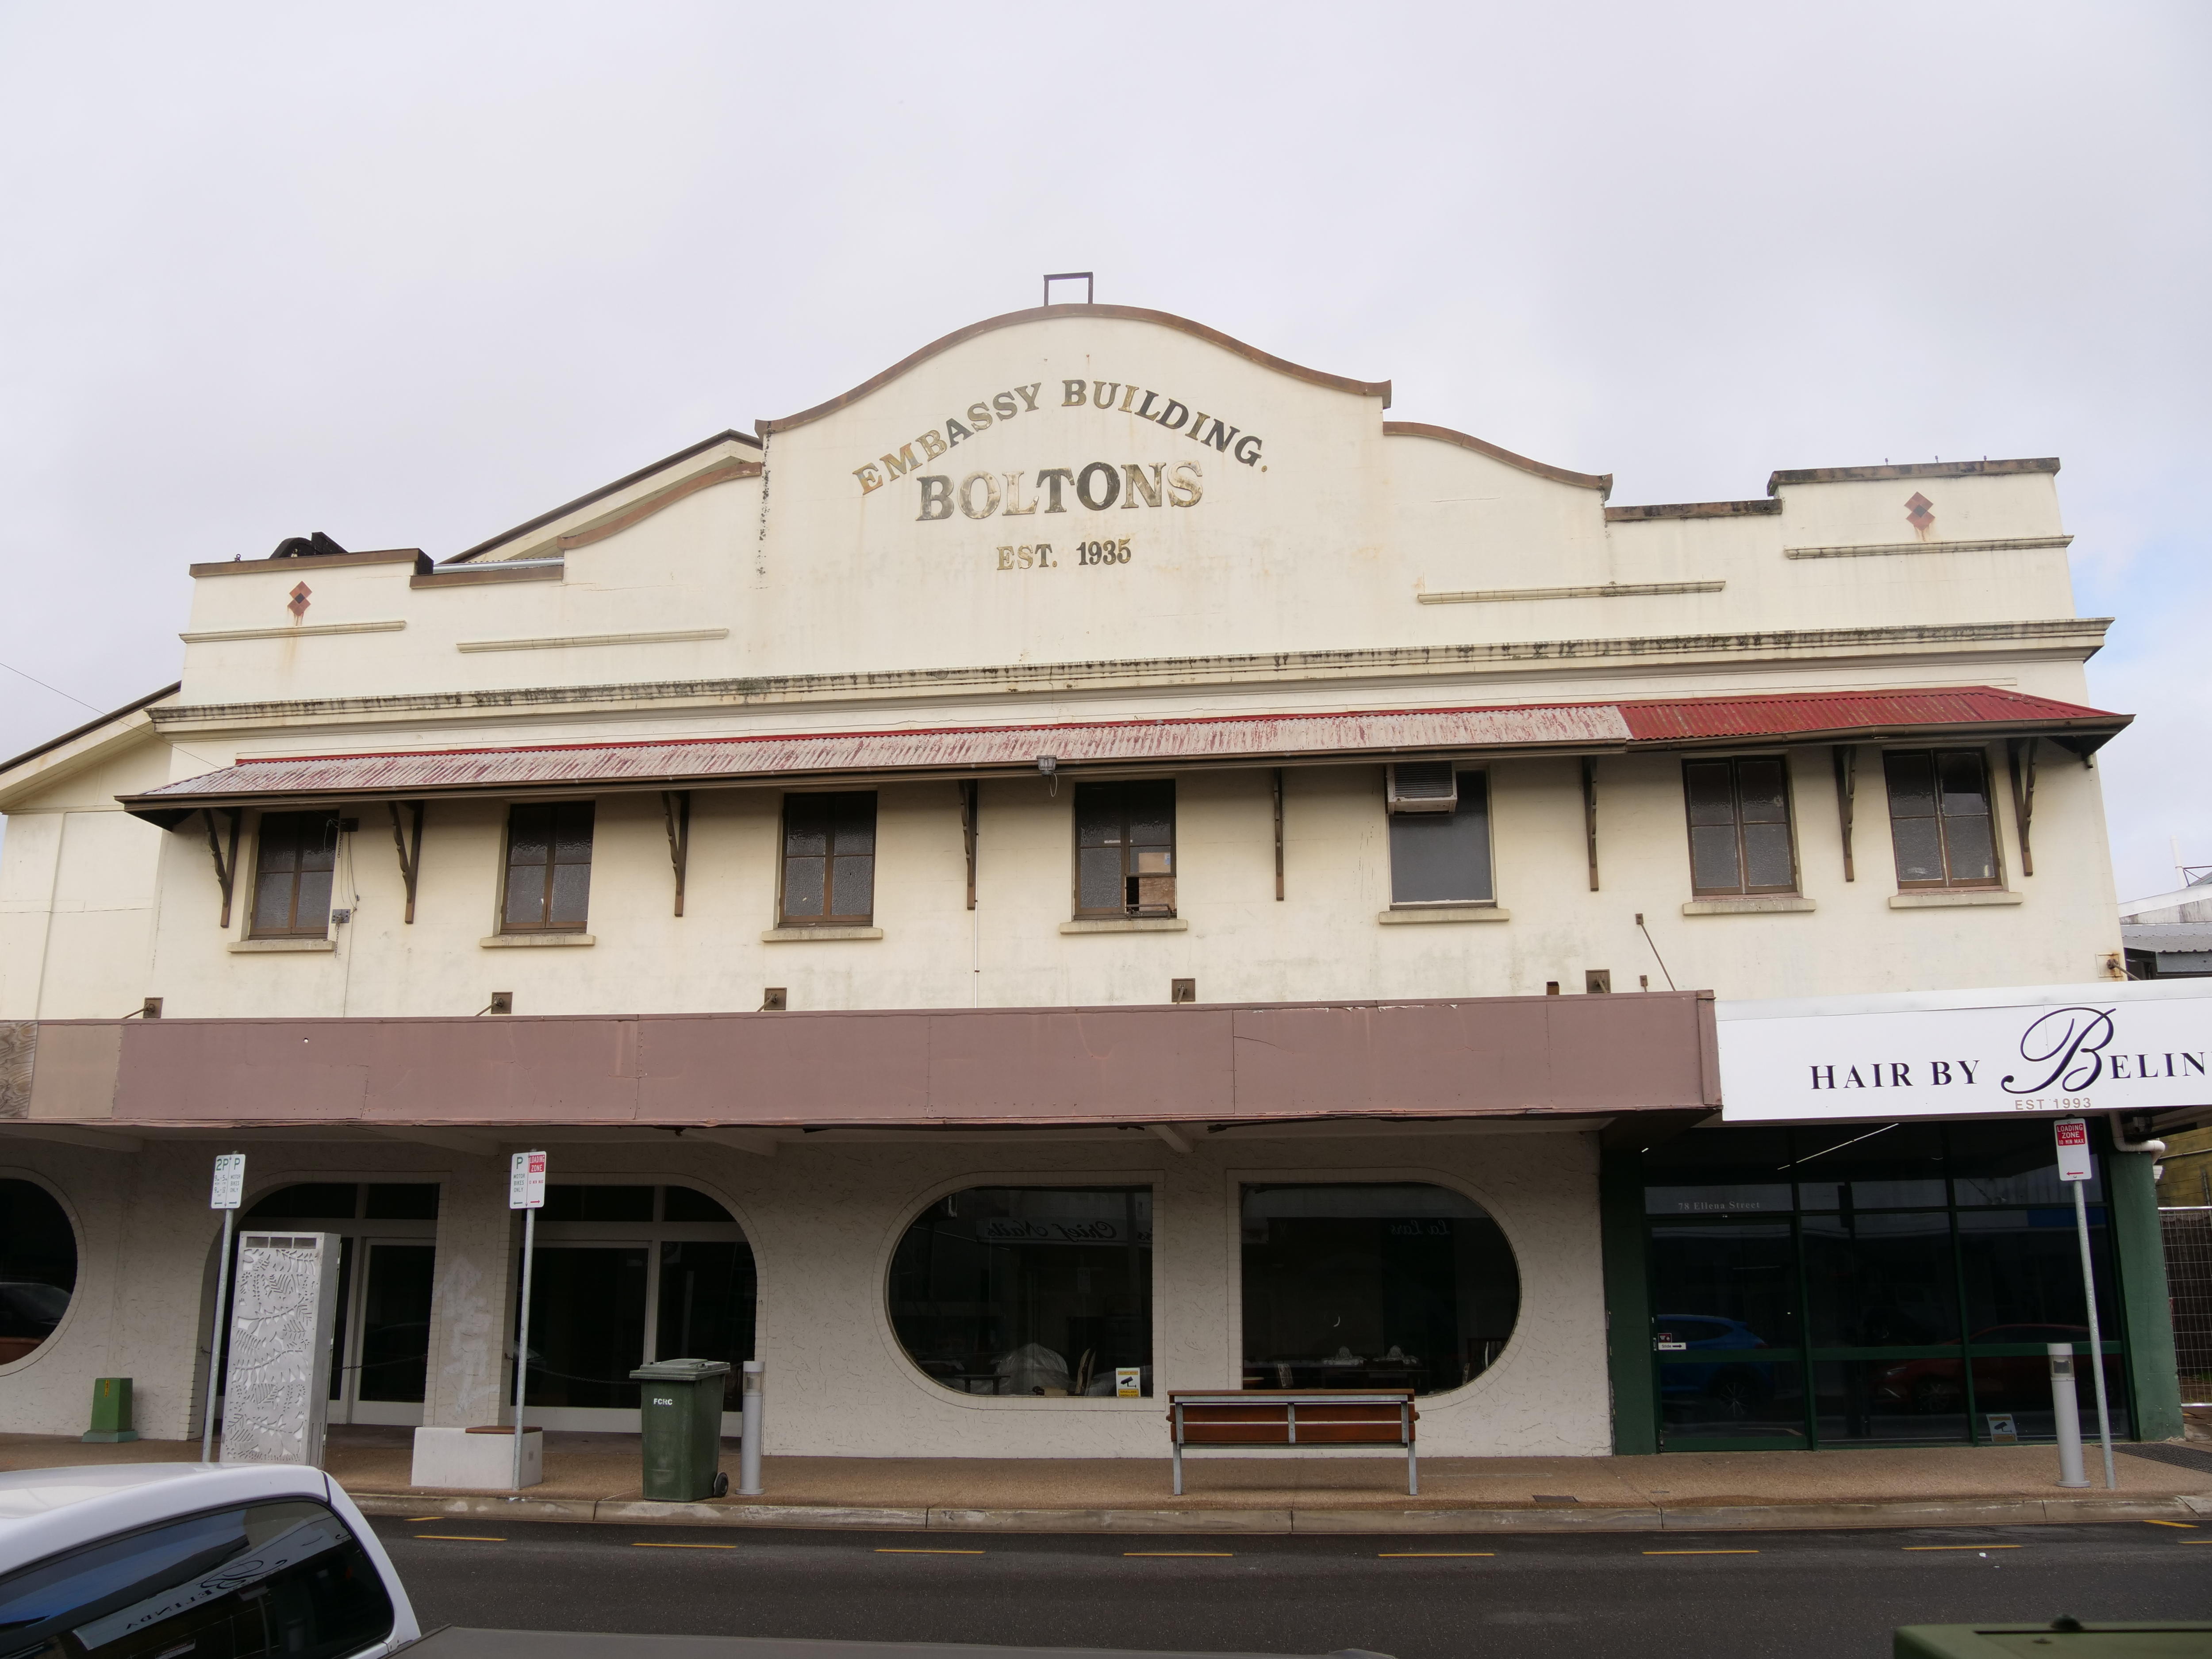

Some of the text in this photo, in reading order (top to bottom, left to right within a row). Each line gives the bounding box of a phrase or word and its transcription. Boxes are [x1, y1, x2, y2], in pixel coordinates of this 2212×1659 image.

[852, 382, 1041, 495] EMBASSY
[915, 461, 1204, 521] BOLTONS
[996, 538, 1132, 570] EST. 1935
[1809, 1007, 2212, 1094] HAIR BY BELIN
[2015, 1097, 2092, 1110] EST 1993
[216, 1158, 229, 1171] 2P
[234, 1157, 241, 1170] P
[516, 1156, 523, 1169] P
[530, 1155, 545, 1164] LOADING
[1694, 1202, 1725, 1210] Ellena
[1729, 1201, 1760, 1209] Street
